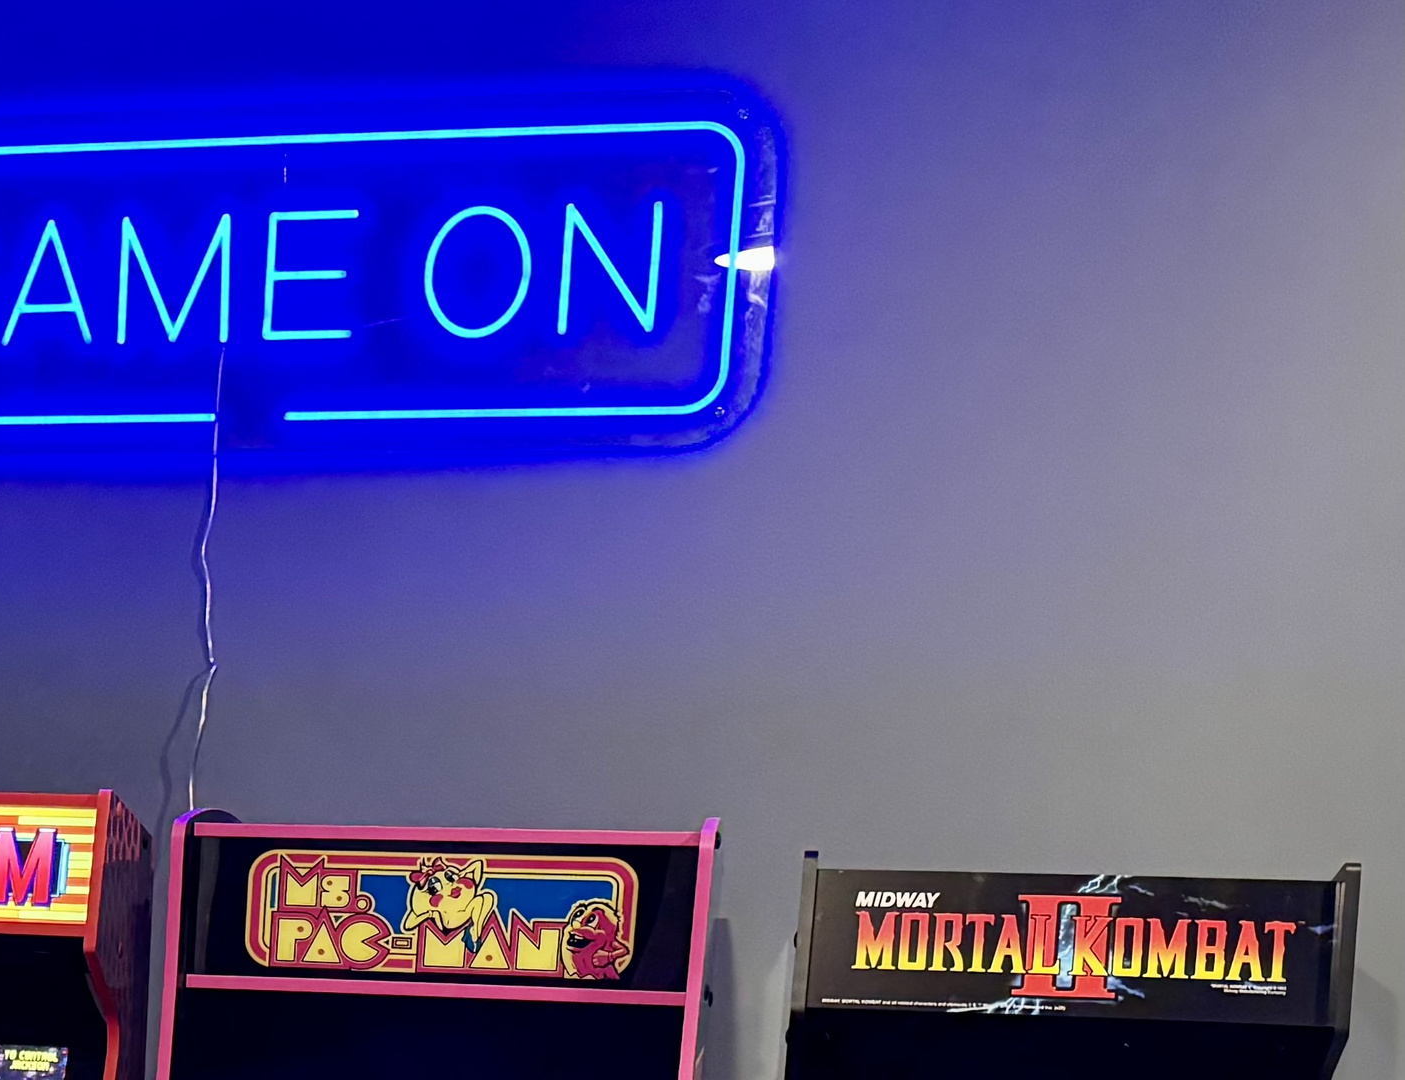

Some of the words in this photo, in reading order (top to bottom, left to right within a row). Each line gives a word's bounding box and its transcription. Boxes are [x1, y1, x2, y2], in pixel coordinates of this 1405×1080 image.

[423, 200, 663, 340] ON
[855, 891, 940, 909] MIDWAY
[271, 908, 564, 973] PAC-MAN
[851, 911, 1062, 976] MORTAL
[1068, 913, 1297, 983] KOMBAT
